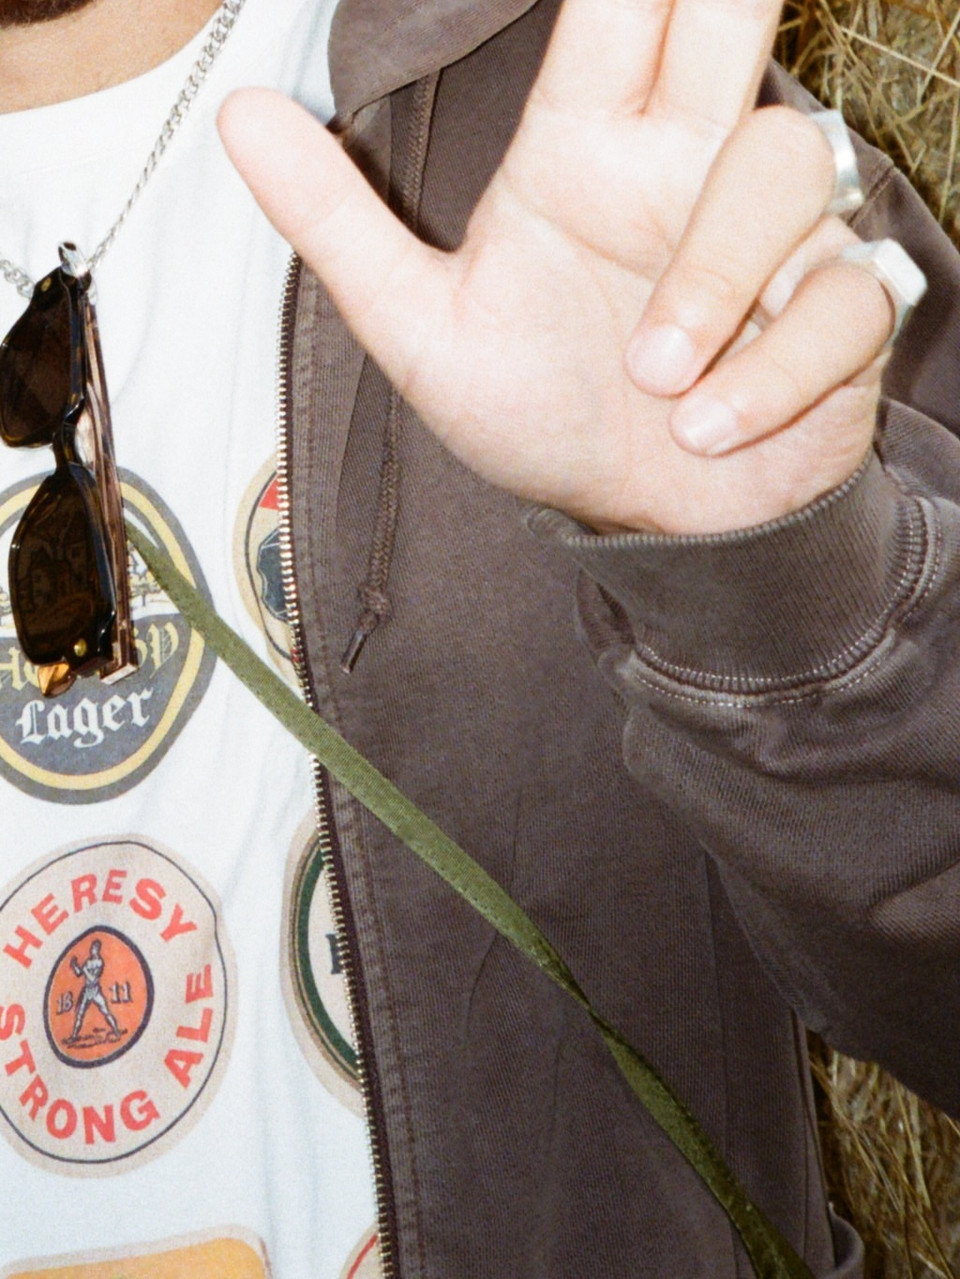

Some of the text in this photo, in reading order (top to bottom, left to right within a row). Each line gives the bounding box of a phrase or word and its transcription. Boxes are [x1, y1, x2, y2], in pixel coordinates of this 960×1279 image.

[16, 686, 154, 749] Lager
[3, 869, 197, 968] HERESY
[164, 963, 214, 1089] ALE
